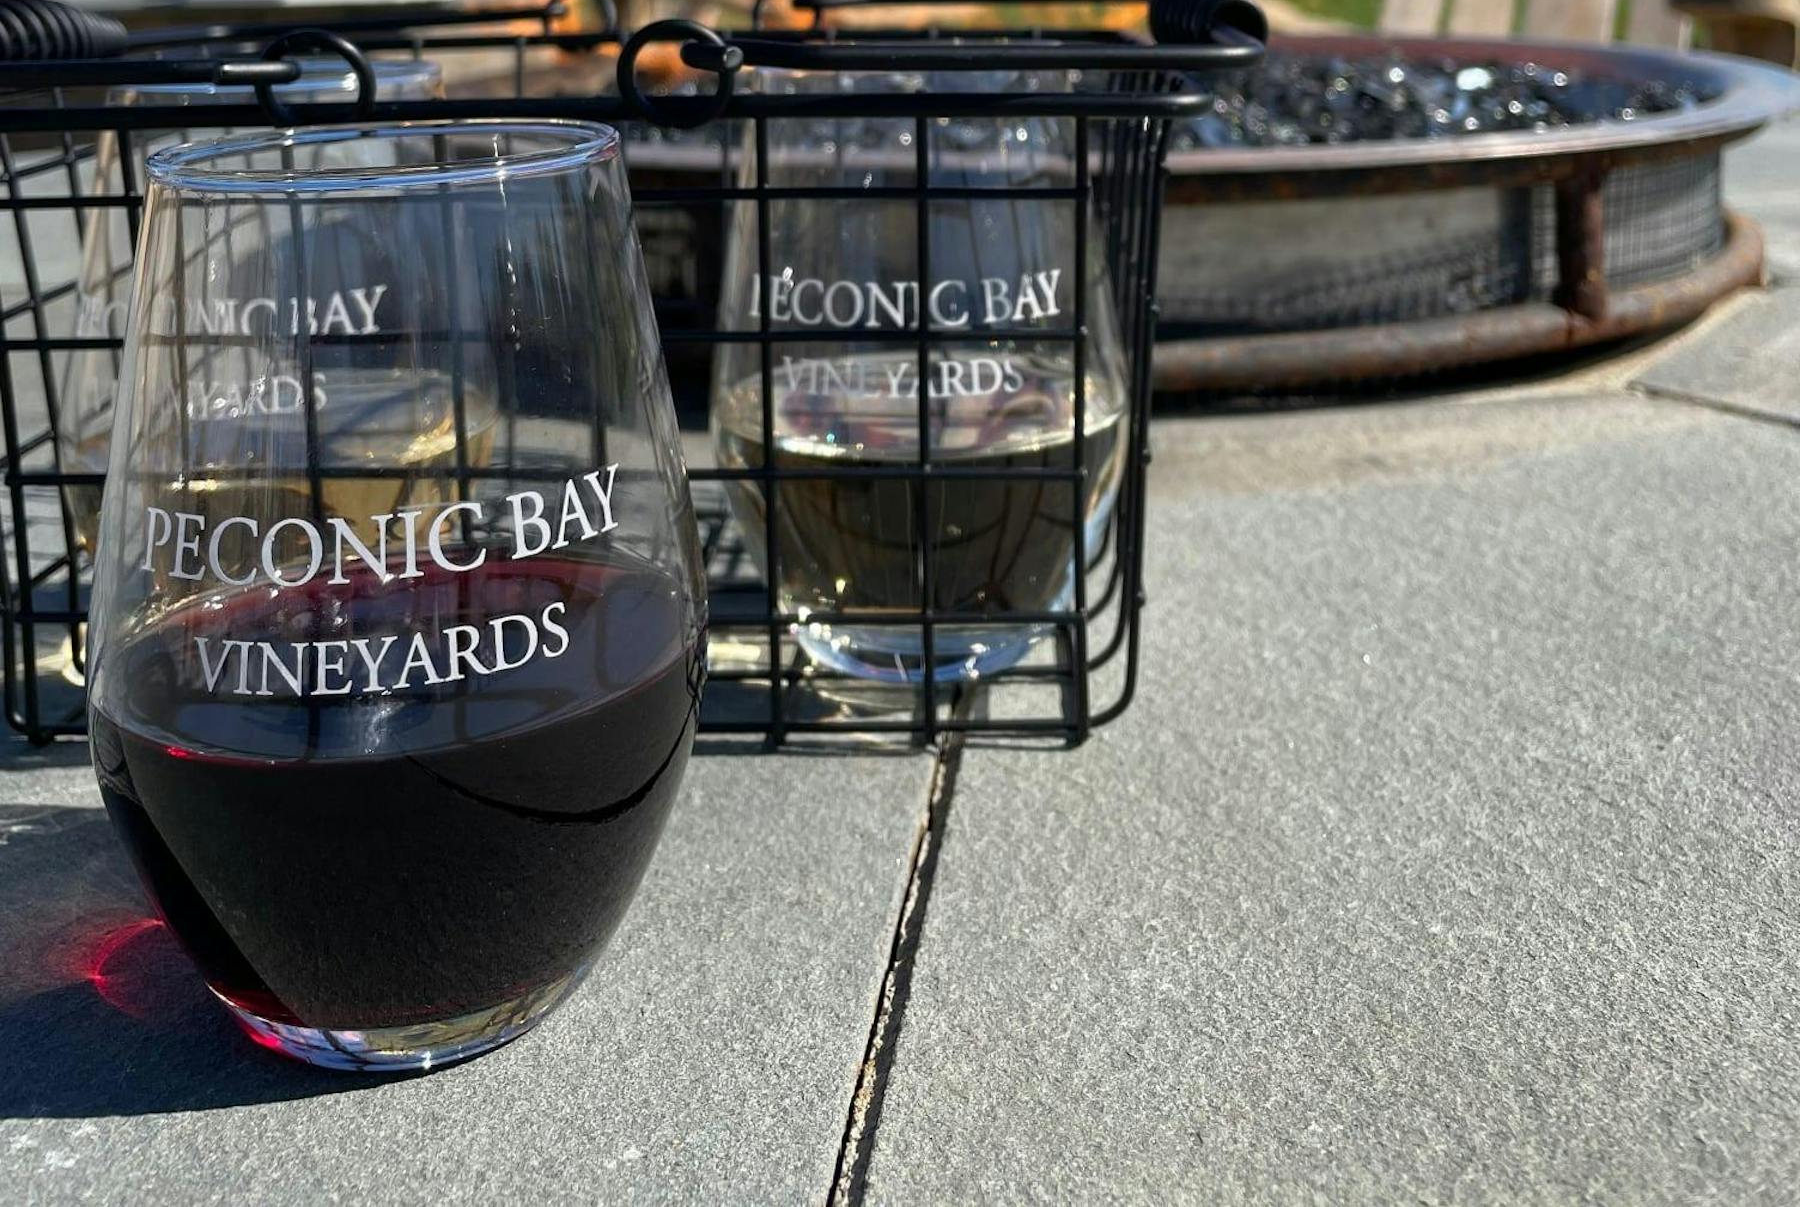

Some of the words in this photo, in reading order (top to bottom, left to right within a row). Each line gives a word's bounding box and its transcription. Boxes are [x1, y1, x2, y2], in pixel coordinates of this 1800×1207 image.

[981, 268, 1062, 323] BAY
[140, 501, 487, 587] PECONIC
[505, 463, 619, 560] BAY
[193, 602, 571, 698] VINEYARDS
